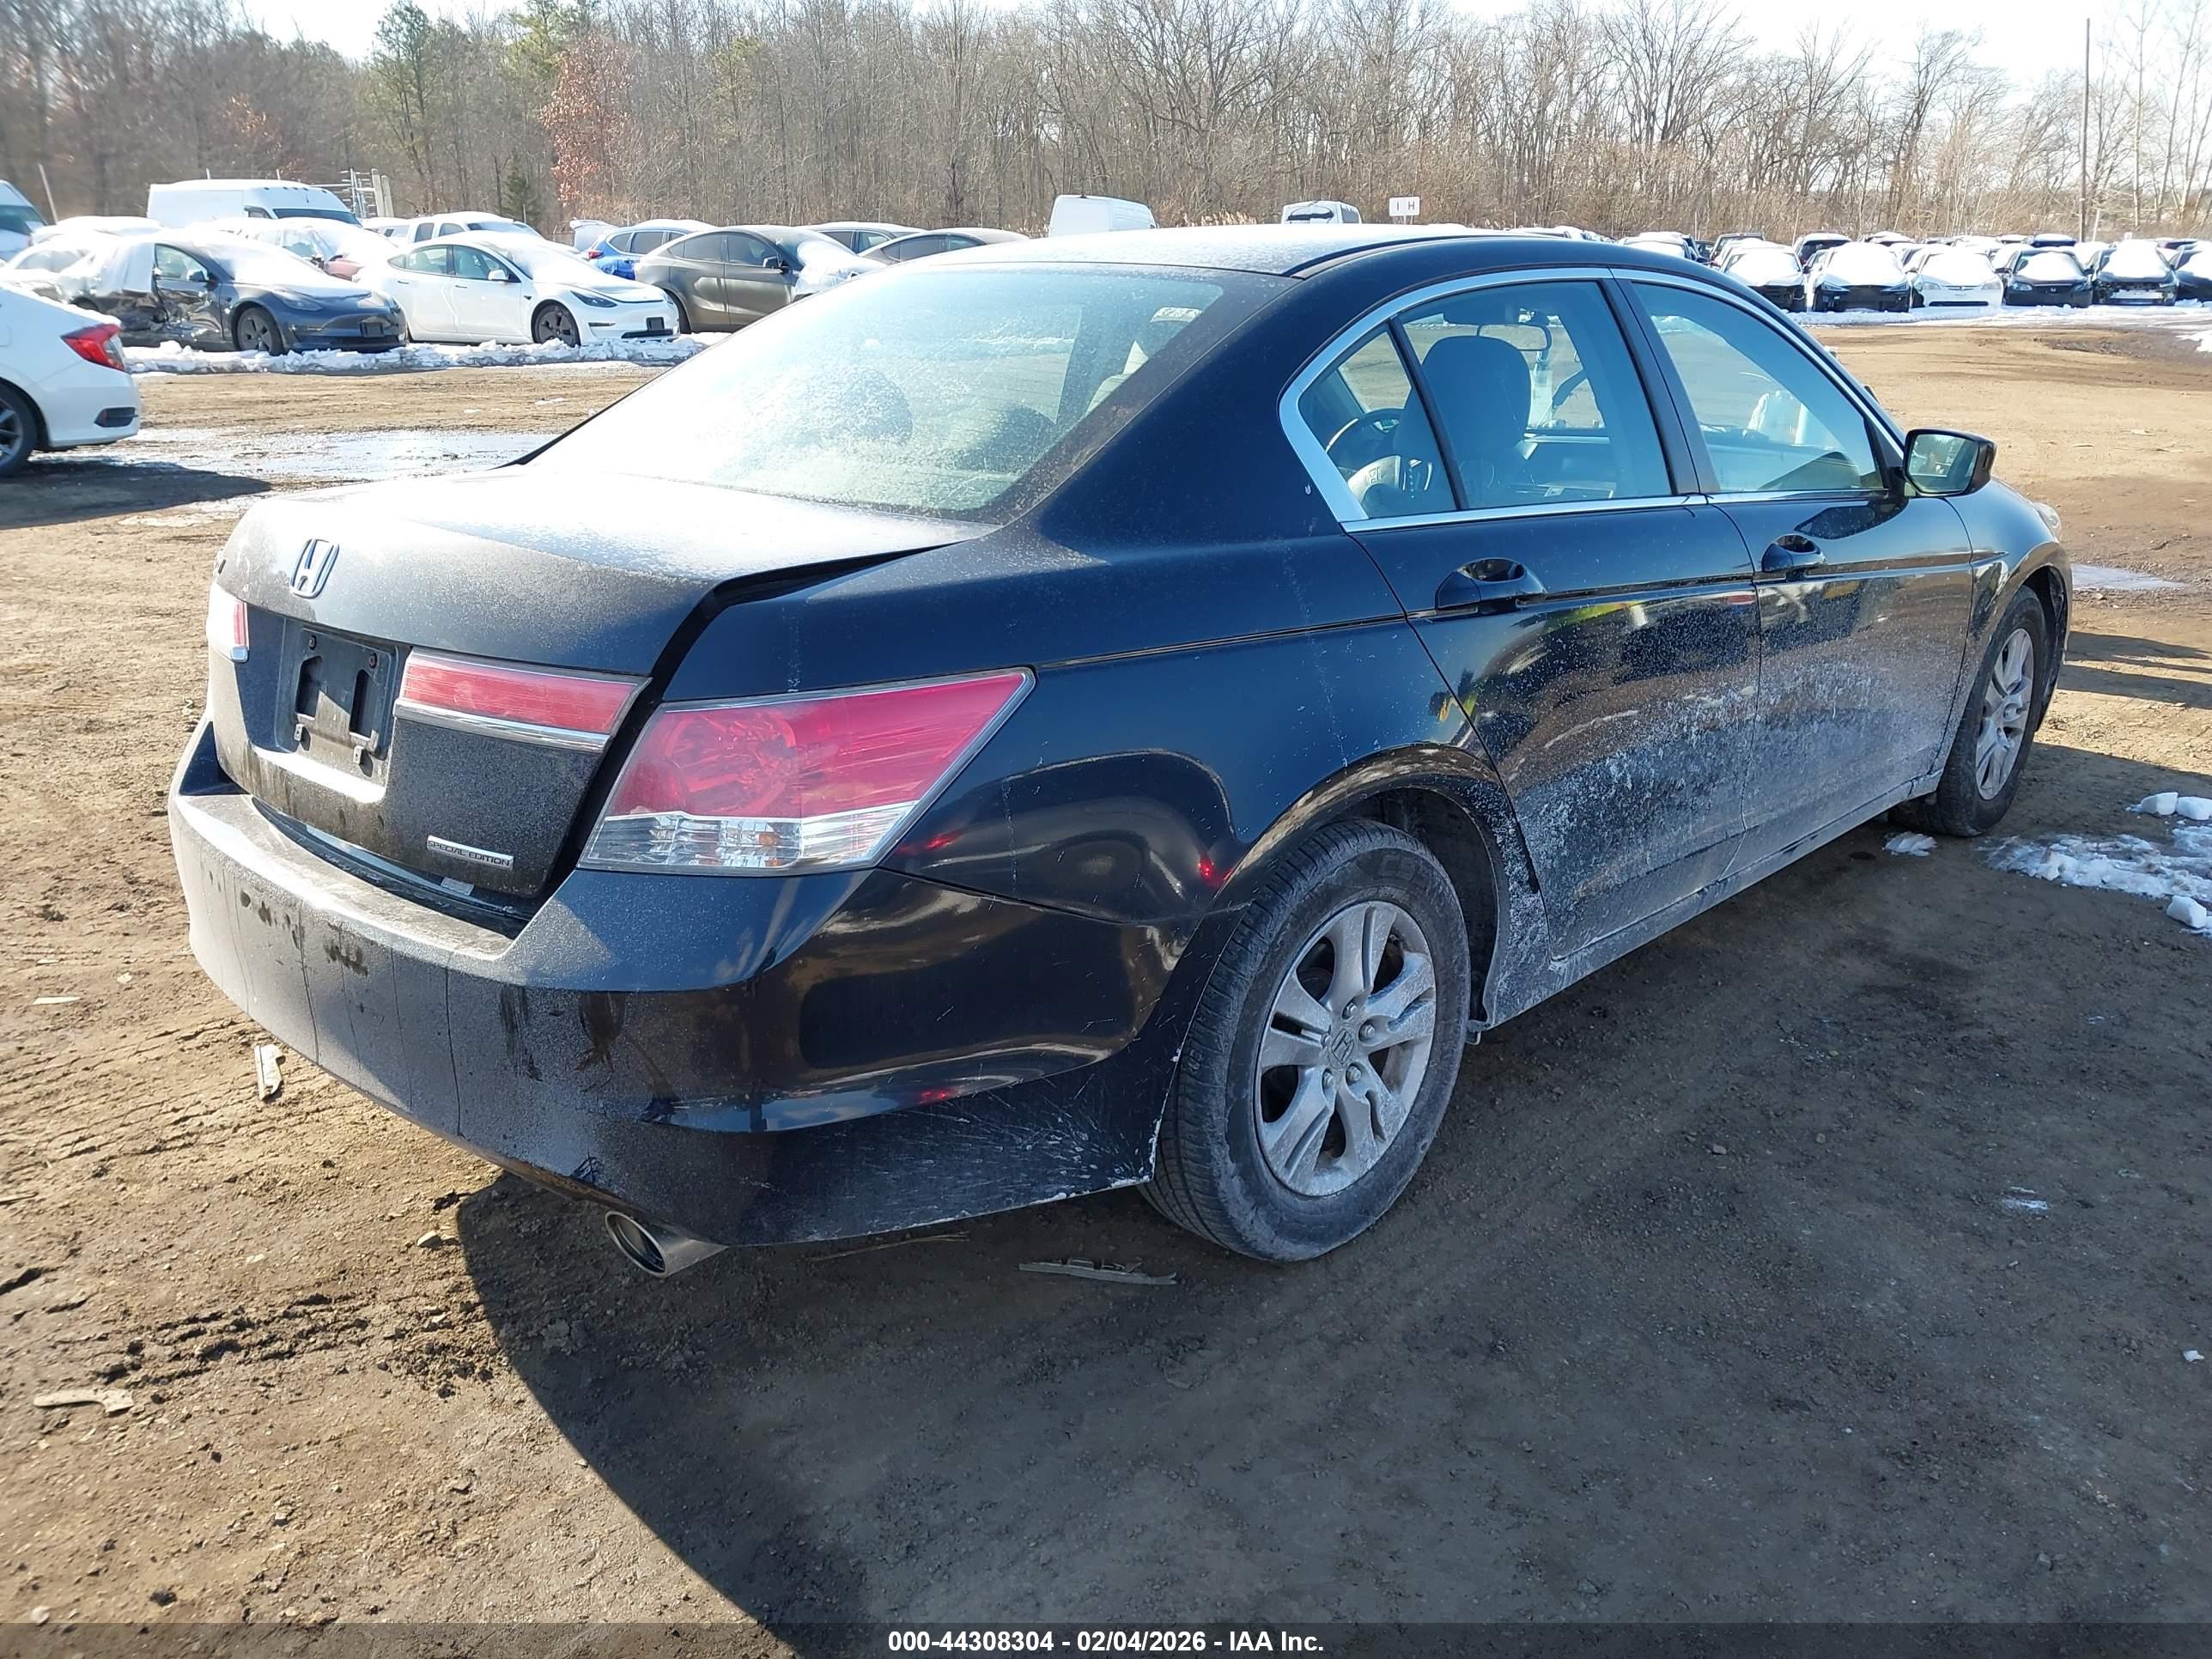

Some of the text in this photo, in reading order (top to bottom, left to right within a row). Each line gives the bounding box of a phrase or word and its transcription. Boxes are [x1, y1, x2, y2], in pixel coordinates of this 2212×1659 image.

[1407, 201, 1415, 210] H
[427, 841, 510, 867] SPECIAL EDITION
